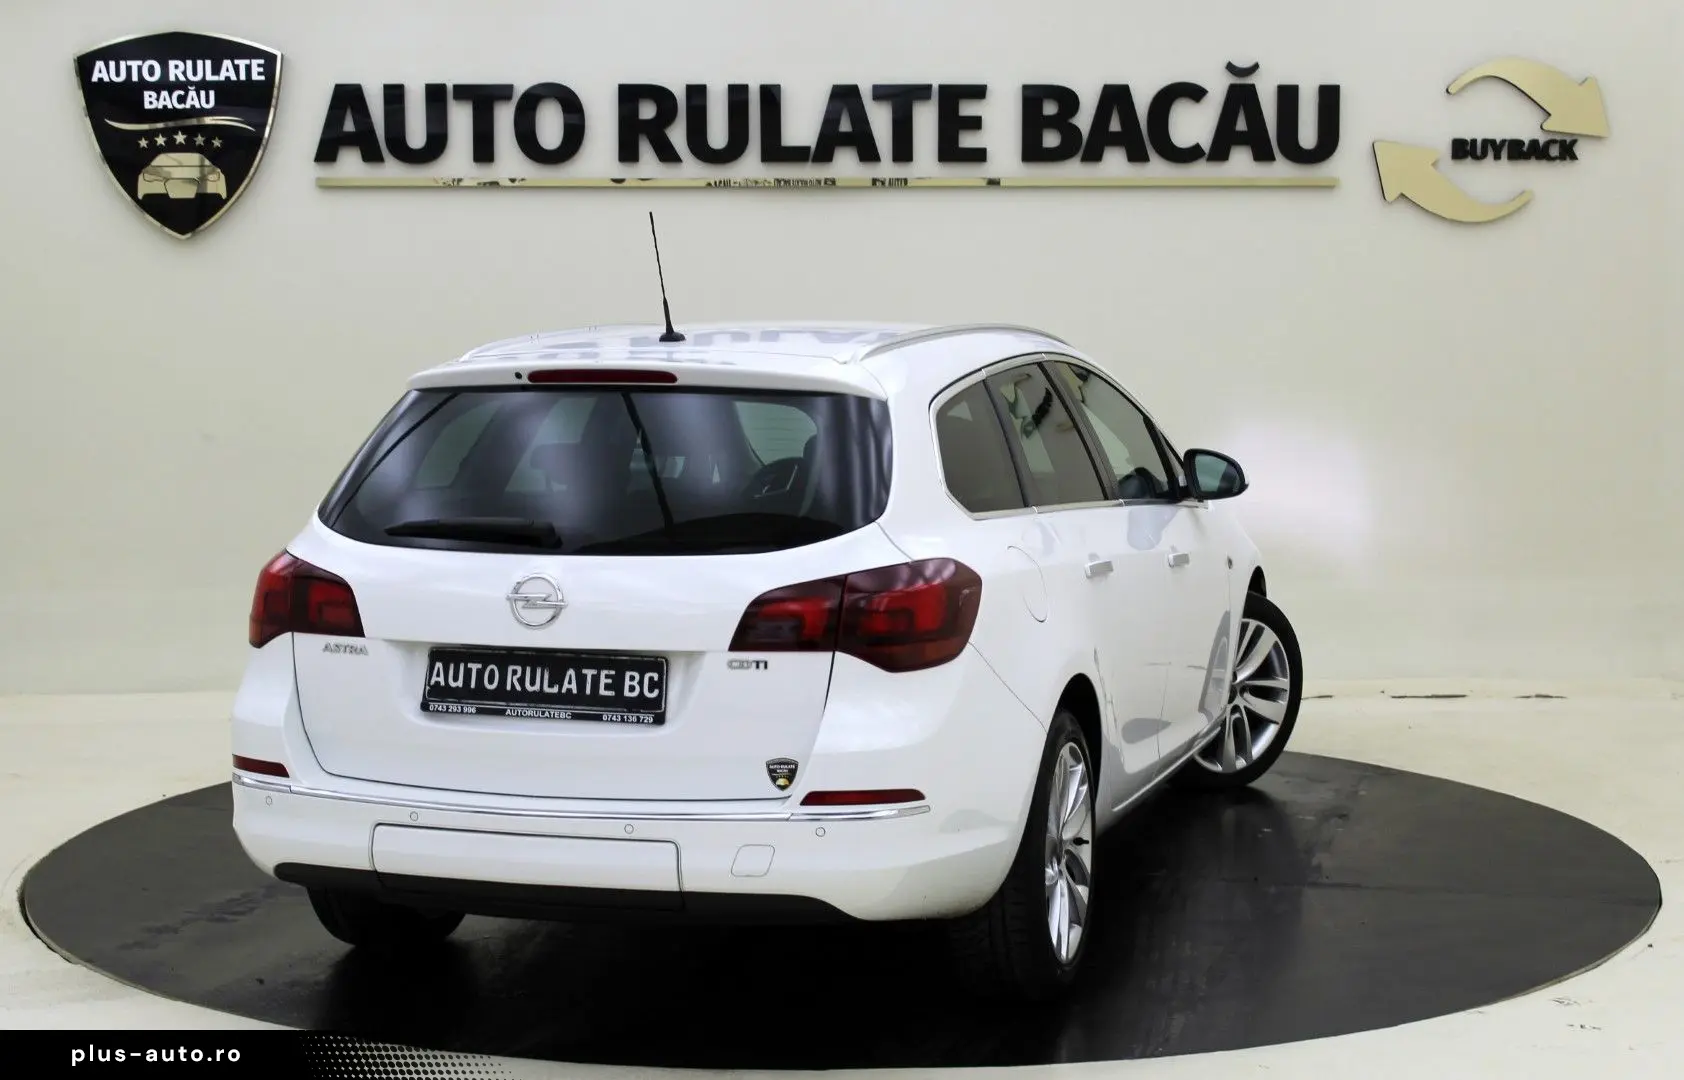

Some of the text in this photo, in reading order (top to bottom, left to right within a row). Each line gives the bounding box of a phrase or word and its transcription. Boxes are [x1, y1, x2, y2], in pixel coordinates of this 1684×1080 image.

[91, 59, 265, 82] AUTO RULATE
[143, 86, 215, 109] BACĂU
[314, 61, 1341, 165] AUTO RULATE BACĂU
[1451, 138, 1579, 161] BUYBACK
[322, 642, 369, 656] ASTRA
[430, 661, 660, 698] AUTO RULATE BC
[429, 704, 447, 712] 0743
[448, 705, 462, 713] 293
[505, 709, 572, 719] AUTORULATEBC
[602, 714, 621, 722] 0743
[639, 716, 654, 724] 729
